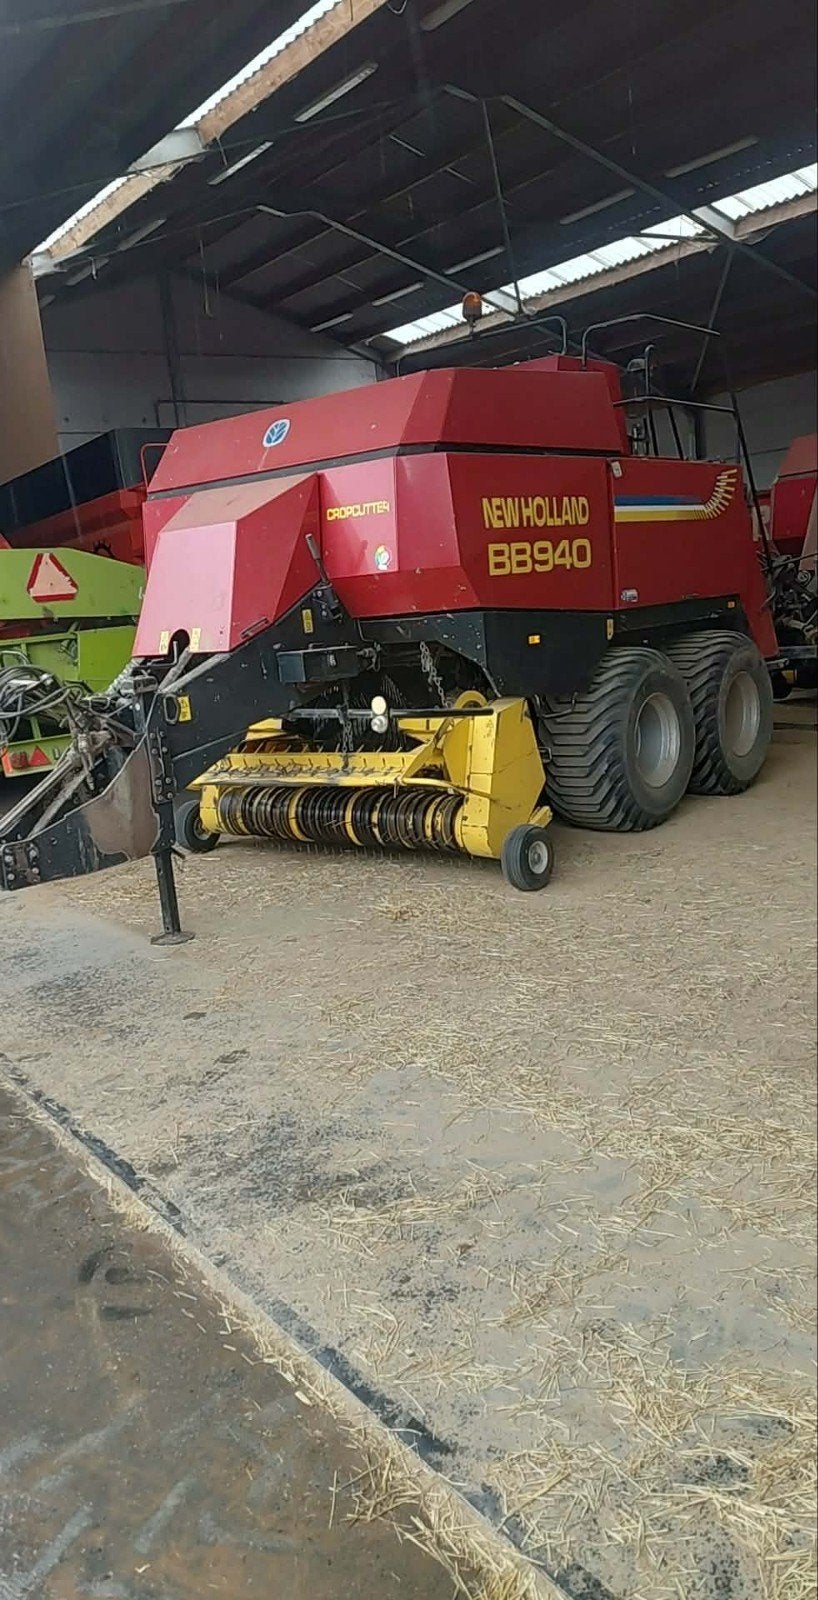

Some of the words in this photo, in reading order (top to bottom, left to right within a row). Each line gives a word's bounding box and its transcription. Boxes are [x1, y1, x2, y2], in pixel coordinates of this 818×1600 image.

[326, 500, 390, 521] CROPCUTTER
[482, 497, 519, 529] NEW
[521, 496, 590, 527] HOLLAND
[487, 538, 591, 576] BB940
